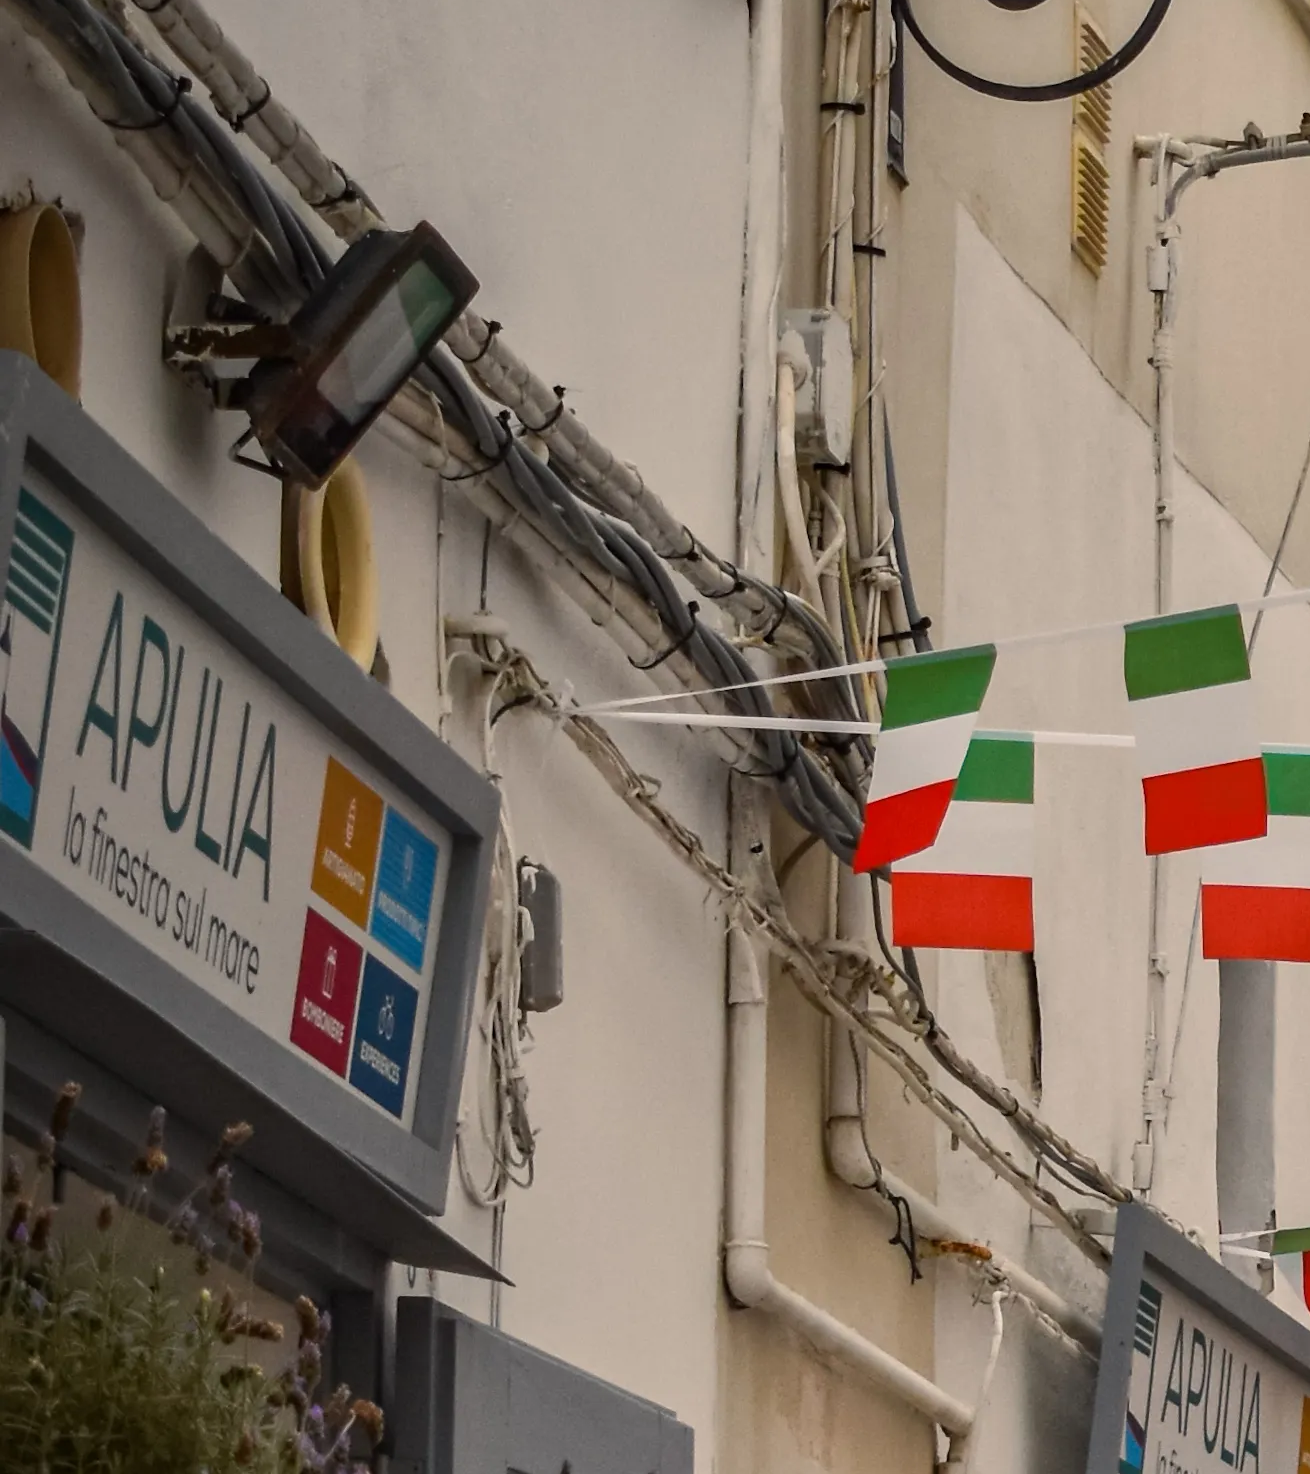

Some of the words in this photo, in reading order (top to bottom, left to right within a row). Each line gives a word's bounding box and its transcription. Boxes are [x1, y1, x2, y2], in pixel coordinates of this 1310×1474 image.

[76, 590, 276, 903] APULIA
[63, 786, 86, 866] la
[88, 808, 171, 929] finestra
[173, 887, 207, 954] sul
[205, 914, 260, 994] mare
